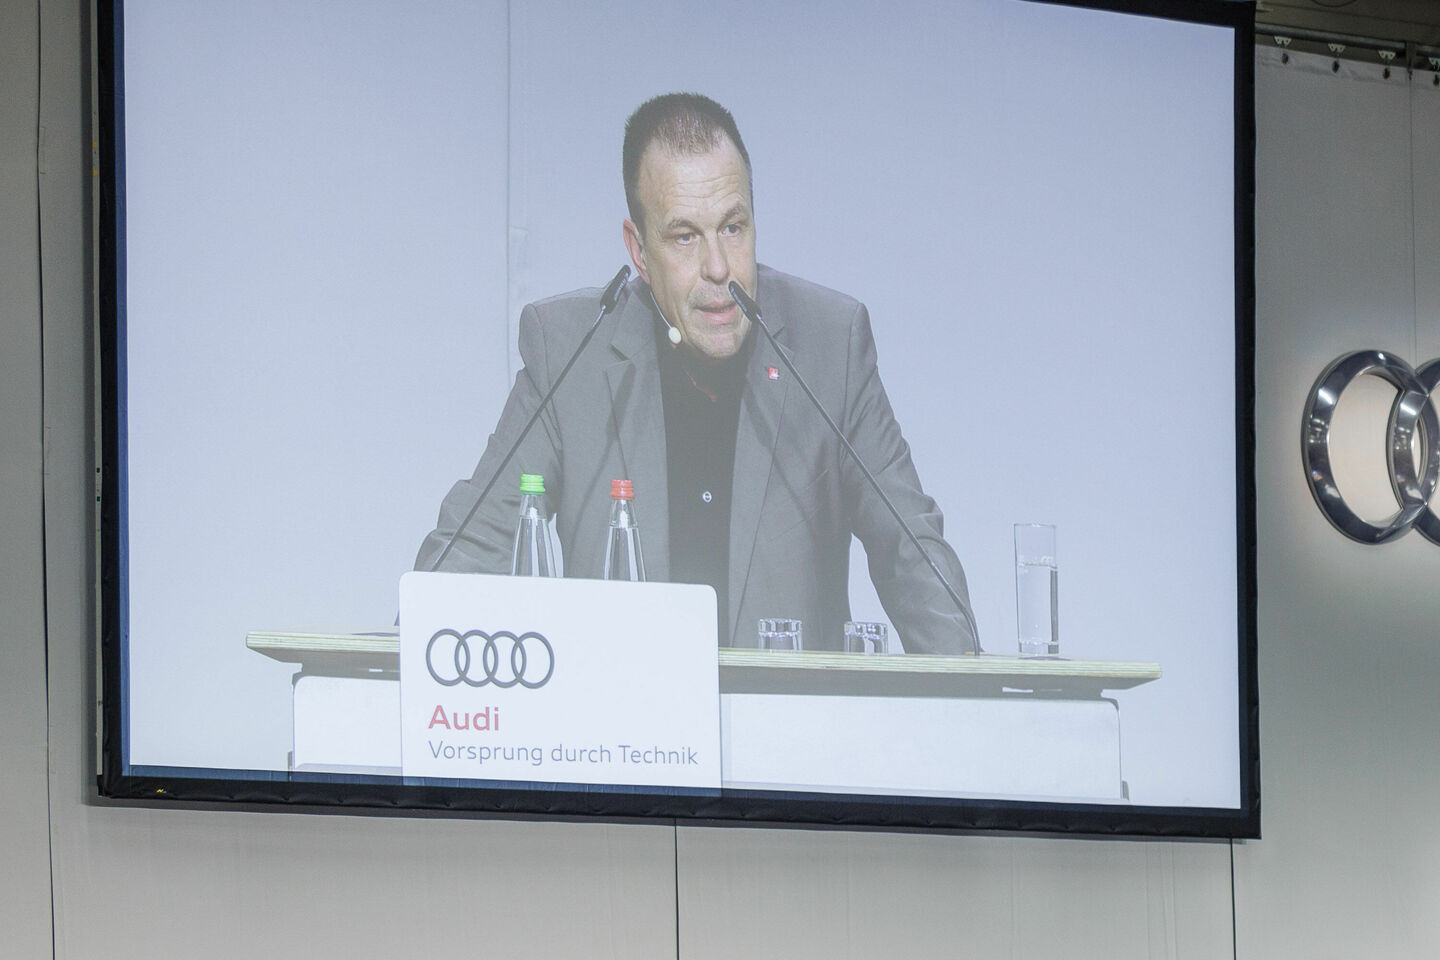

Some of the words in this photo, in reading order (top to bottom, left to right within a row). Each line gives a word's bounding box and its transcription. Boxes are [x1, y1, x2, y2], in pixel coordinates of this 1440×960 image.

[428, 704, 500, 731] Audi
[428, 740, 543, 766] Vorsprung
[551, 743, 611, 764] durch
[618, 745, 699, 765] Technik
